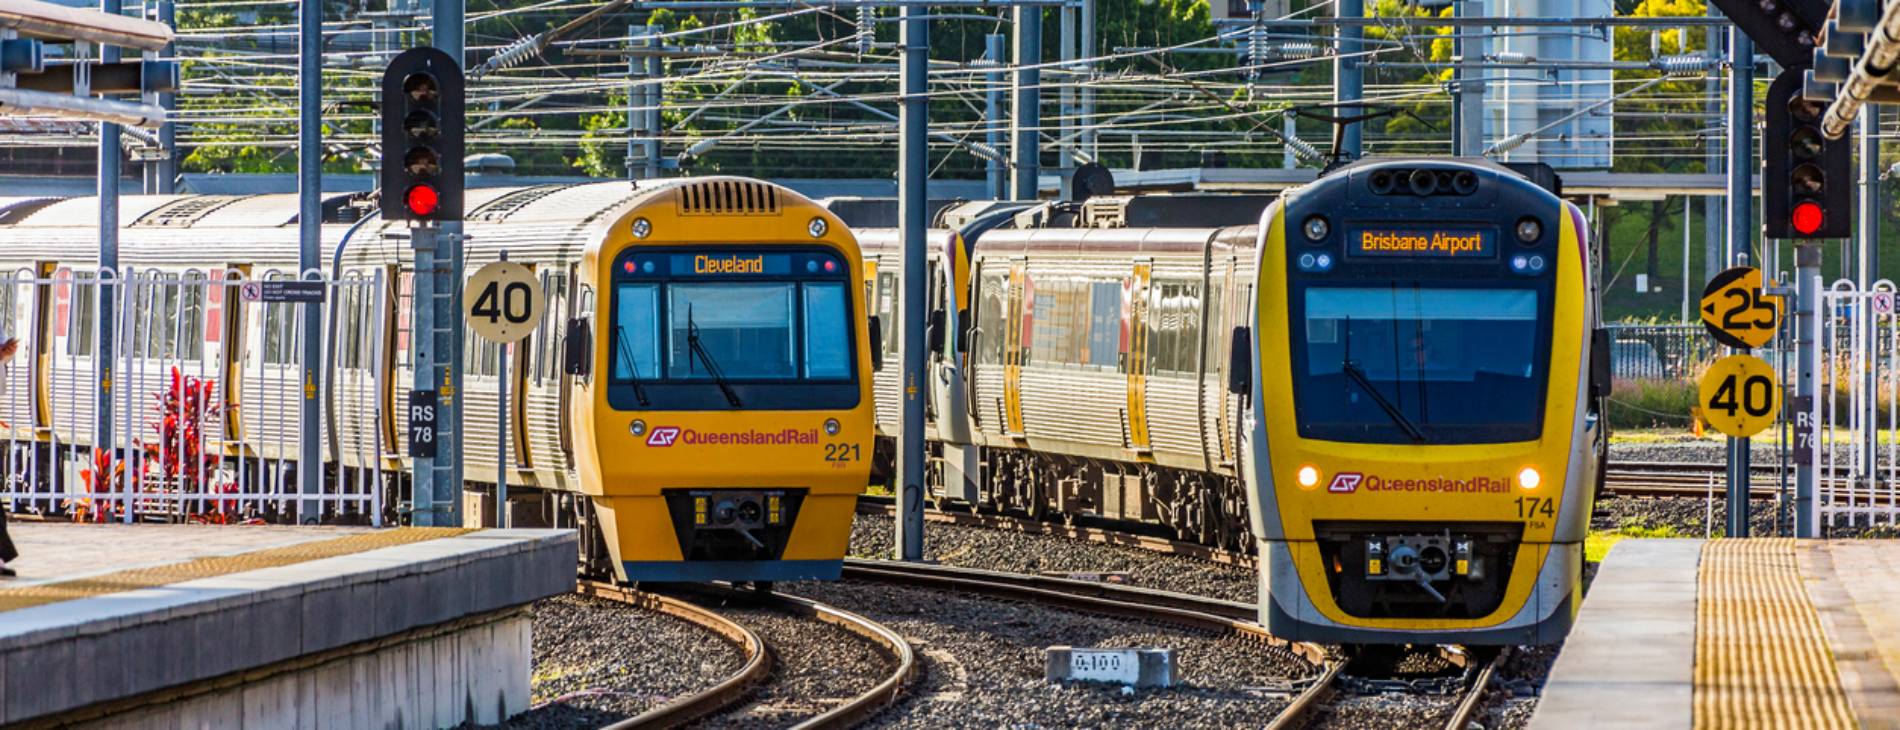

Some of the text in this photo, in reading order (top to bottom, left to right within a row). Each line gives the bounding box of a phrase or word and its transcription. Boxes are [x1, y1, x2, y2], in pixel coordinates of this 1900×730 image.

[1362, 230, 1482, 256] Brisbane Airport
[694, 254, 763, 274] Cleveland
[471, 281, 532, 324] 40
[1722, 287, 1776, 330] 25
[1708, 374, 1773, 418] 40
[411, 405, 434, 422] RS
[413, 427, 433, 443] 78
[682, 428, 819, 445] QueenslandRail
[824, 442, 860, 462] 221
[1365, 475, 1511, 494] QueenslandRail
[1514, 495, 1555, 518] 174
